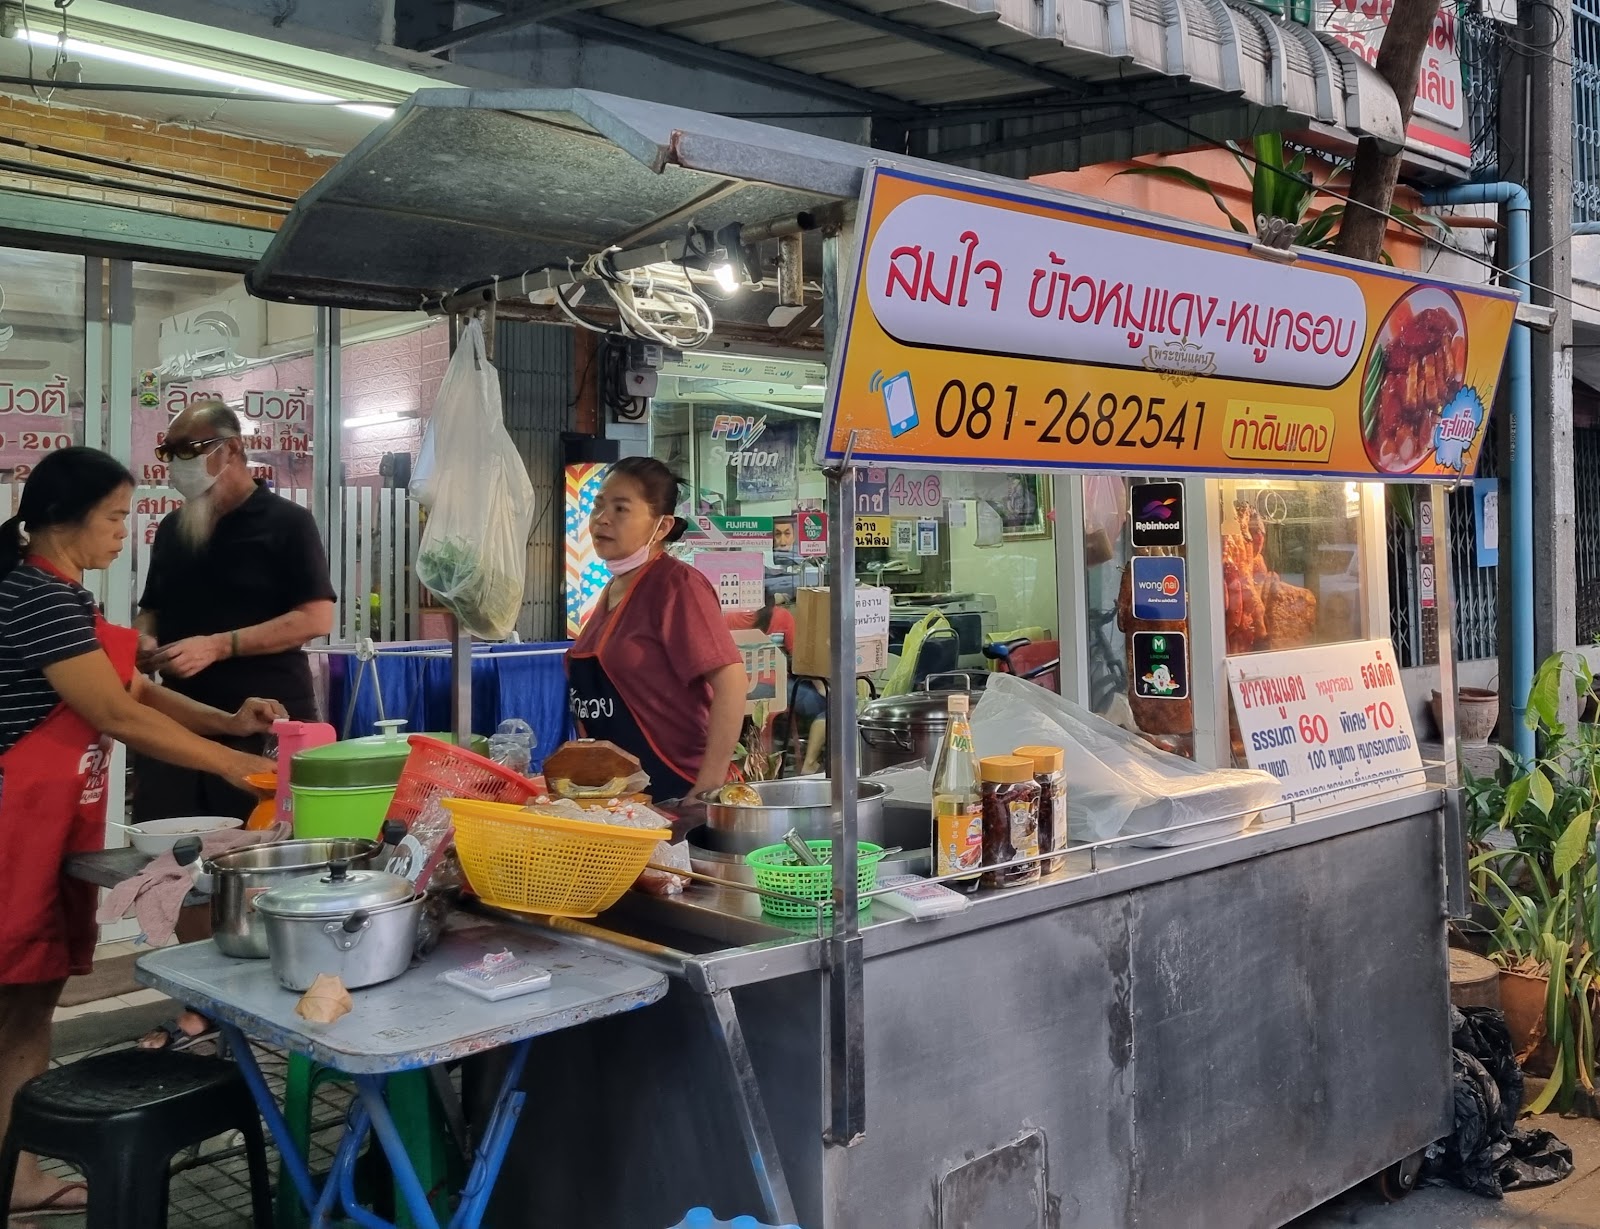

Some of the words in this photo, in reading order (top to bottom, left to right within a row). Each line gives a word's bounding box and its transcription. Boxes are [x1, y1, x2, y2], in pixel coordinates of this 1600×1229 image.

[885, 230, 1003, 312] สมใจ
[1028, 251, 1357, 364] ข้าวหมูแดง-หมูกรอบ
[245, 386, 308, 421] บิวตี้
[935, 379, 1206, 451] 081-2682541
[1229, 406, 1328, 453] ท่าดินแดง
[1441, 408, 1475, 439] รสเด็ด
[890, 473, 942, 507] 4x6
[725, 521, 758, 529] FUJIFILM
[1135, 521, 1180, 532] Robinhood
[1315, 676, 1354, 703] หมูกรอบ
[1360, 650, 1396, 690] รสเด็ด
[1298, 714, 1329, 744] 60
[1339, 711, 1367, 734] พิเศษ
[1365, 701, 1394, 731] 70
[1307, 749, 1327, 771] 100
